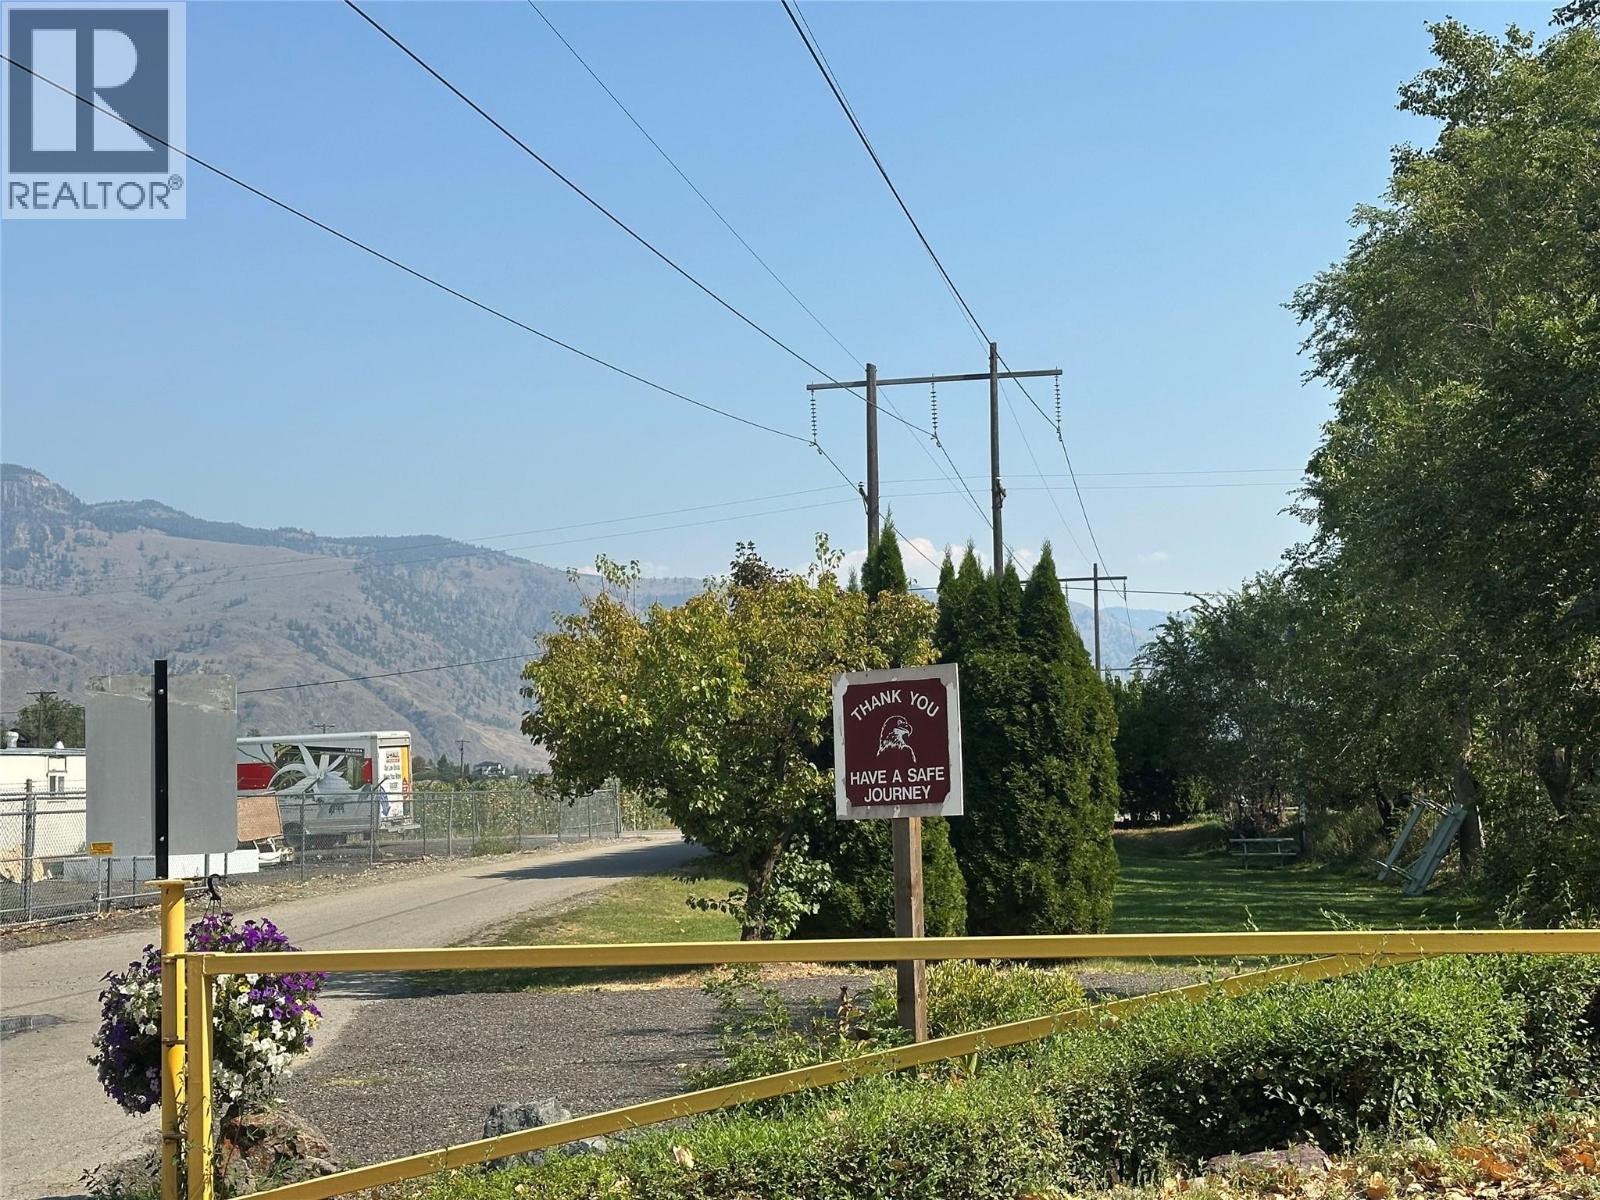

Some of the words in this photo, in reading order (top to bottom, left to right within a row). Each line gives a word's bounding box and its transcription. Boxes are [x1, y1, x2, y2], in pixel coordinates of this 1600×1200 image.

[850, 689, 902, 721] THANK
[909, 690, 940, 717] YOU
[850, 769, 887, 785] HAVE
[891, 770, 902, 783] A
[907, 766, 945, 782] SAFE
[864, 785, 931, 802] JOURNEY
